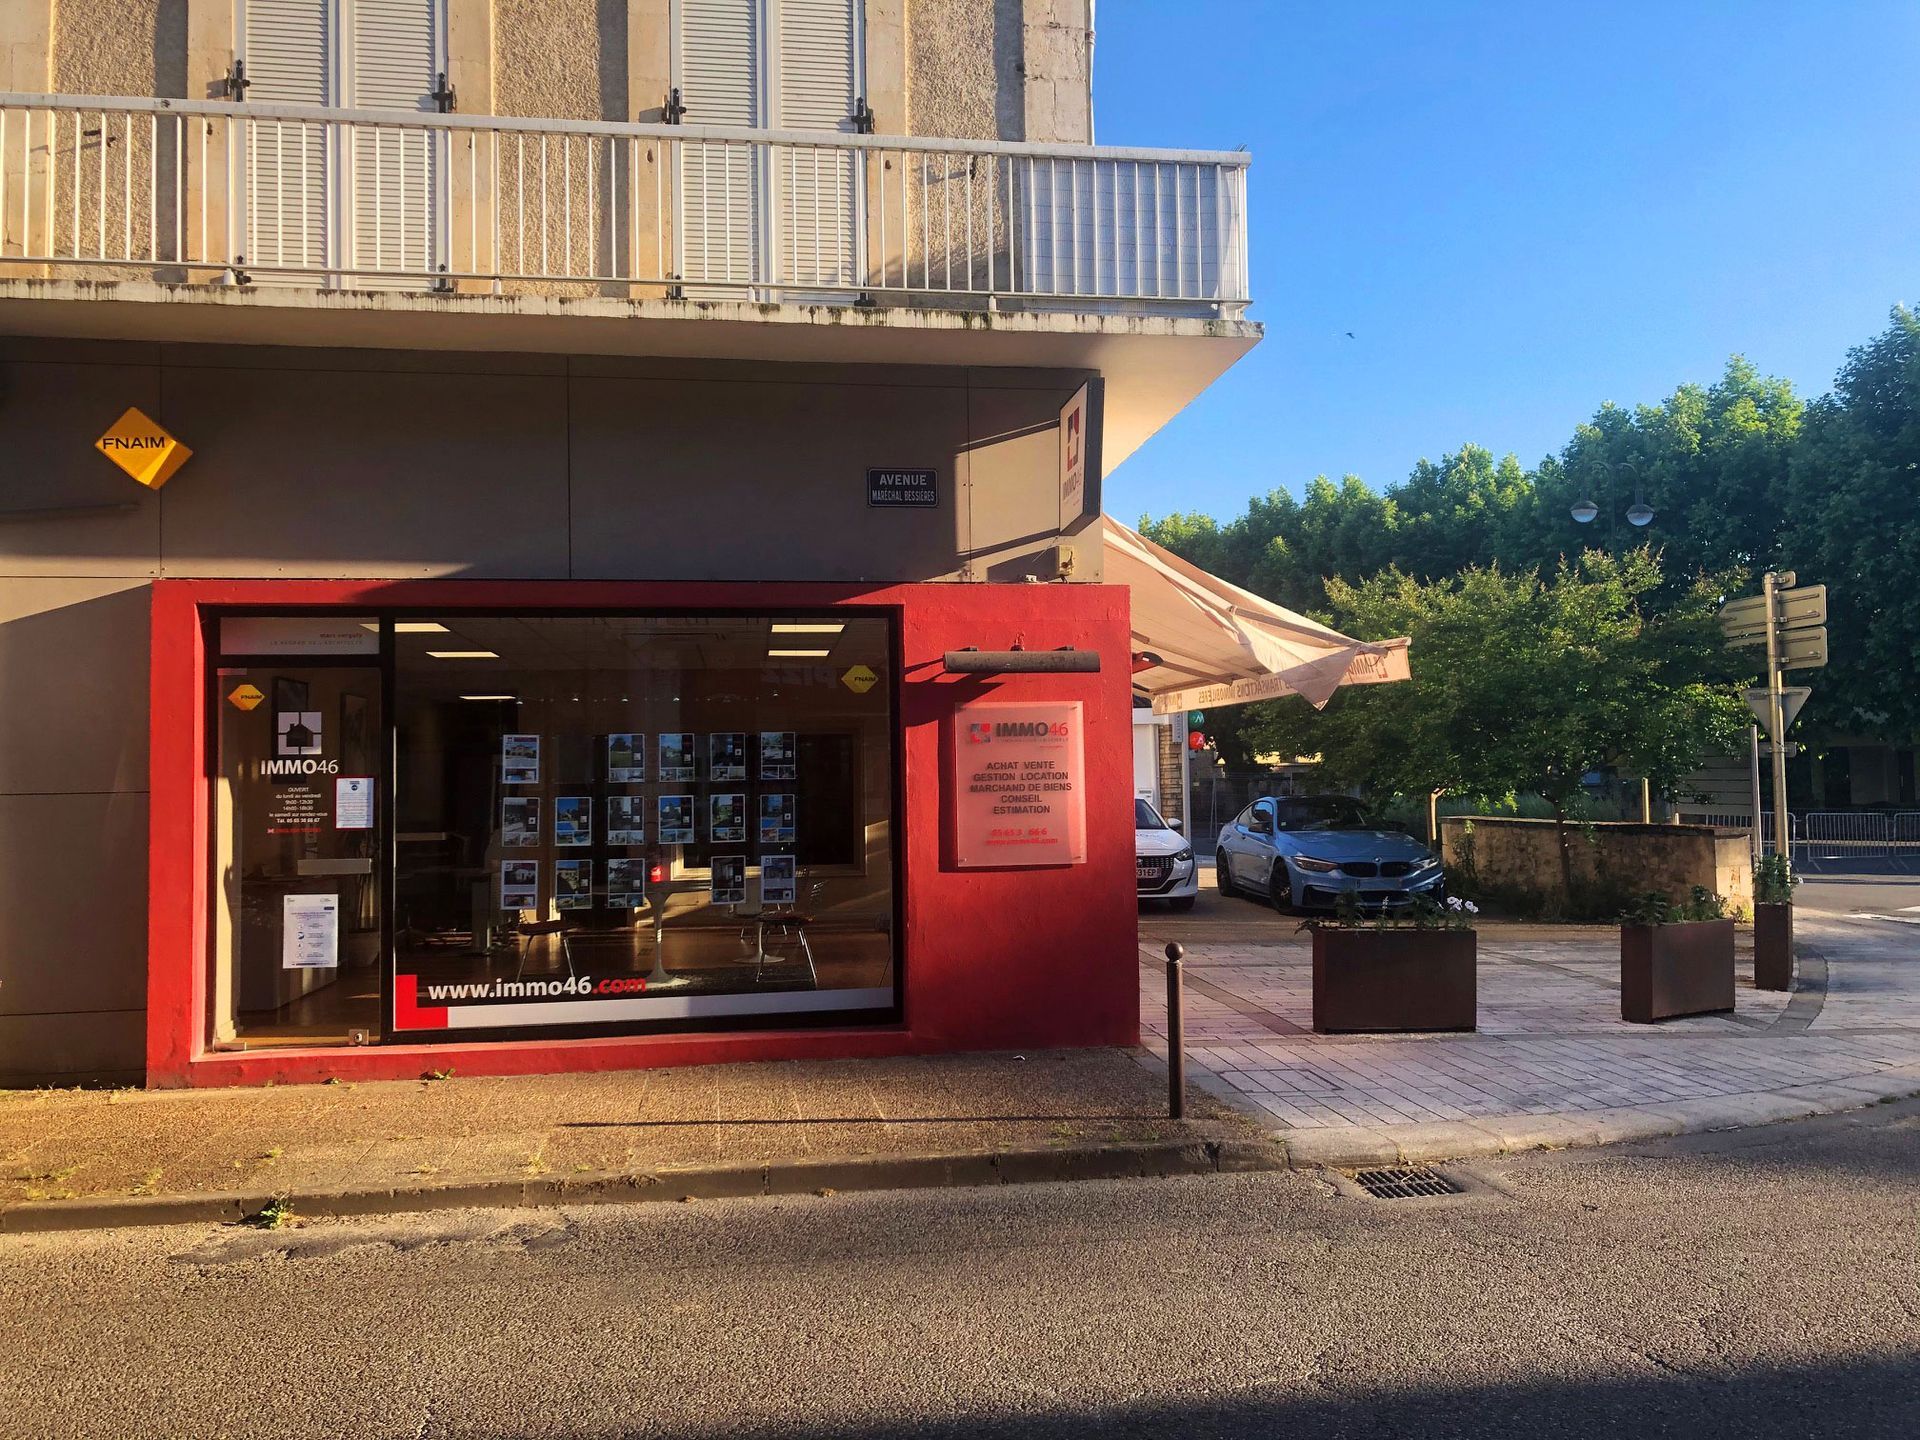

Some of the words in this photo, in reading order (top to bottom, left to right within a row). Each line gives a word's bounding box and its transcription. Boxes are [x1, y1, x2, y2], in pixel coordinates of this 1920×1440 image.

[102, 436, 165, 450] FNAIM
[879, 474, 927, 486] AVENUE
[995, 722, 1069, 738] IMMO46
[260, 759, 339, 775] IMMO46
[986, 761, 1019, 770] ACHAT
[1023, 761, 1056, 770] VENTE
[973, 773, 1016, 782] GESTION
[1020, 771, 1069, 781] LOCATION
[970, 784, 1026, 793] MARCHAND
[1028, 784, 1042, 792] DE
[1043, 783, 1072, 792] BIENS
[1001, 795, 1042, 804] CONSEIL
[993, 805, 1050, 815] ESTIMATION
[428, 976, 647, 999] www.immo46.com
